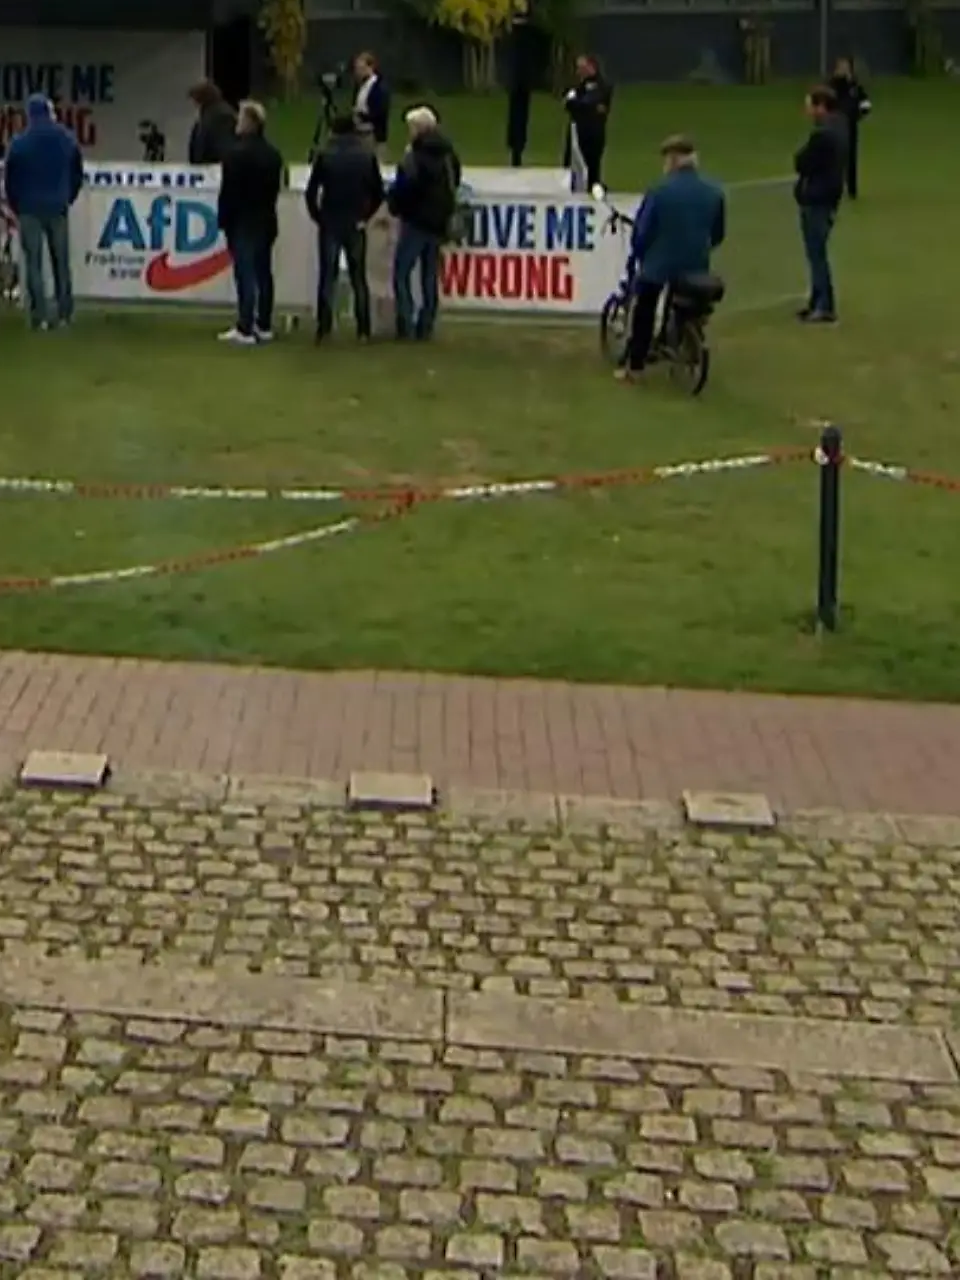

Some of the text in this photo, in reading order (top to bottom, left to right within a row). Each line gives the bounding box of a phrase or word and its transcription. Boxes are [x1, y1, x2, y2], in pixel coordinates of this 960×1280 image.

[72, 64, 115, 103] ME
[98, 195, 219, 252] AfD
[458, 204, 595, 251] OVE ME
[441, 252, 573, 301] WRONG
